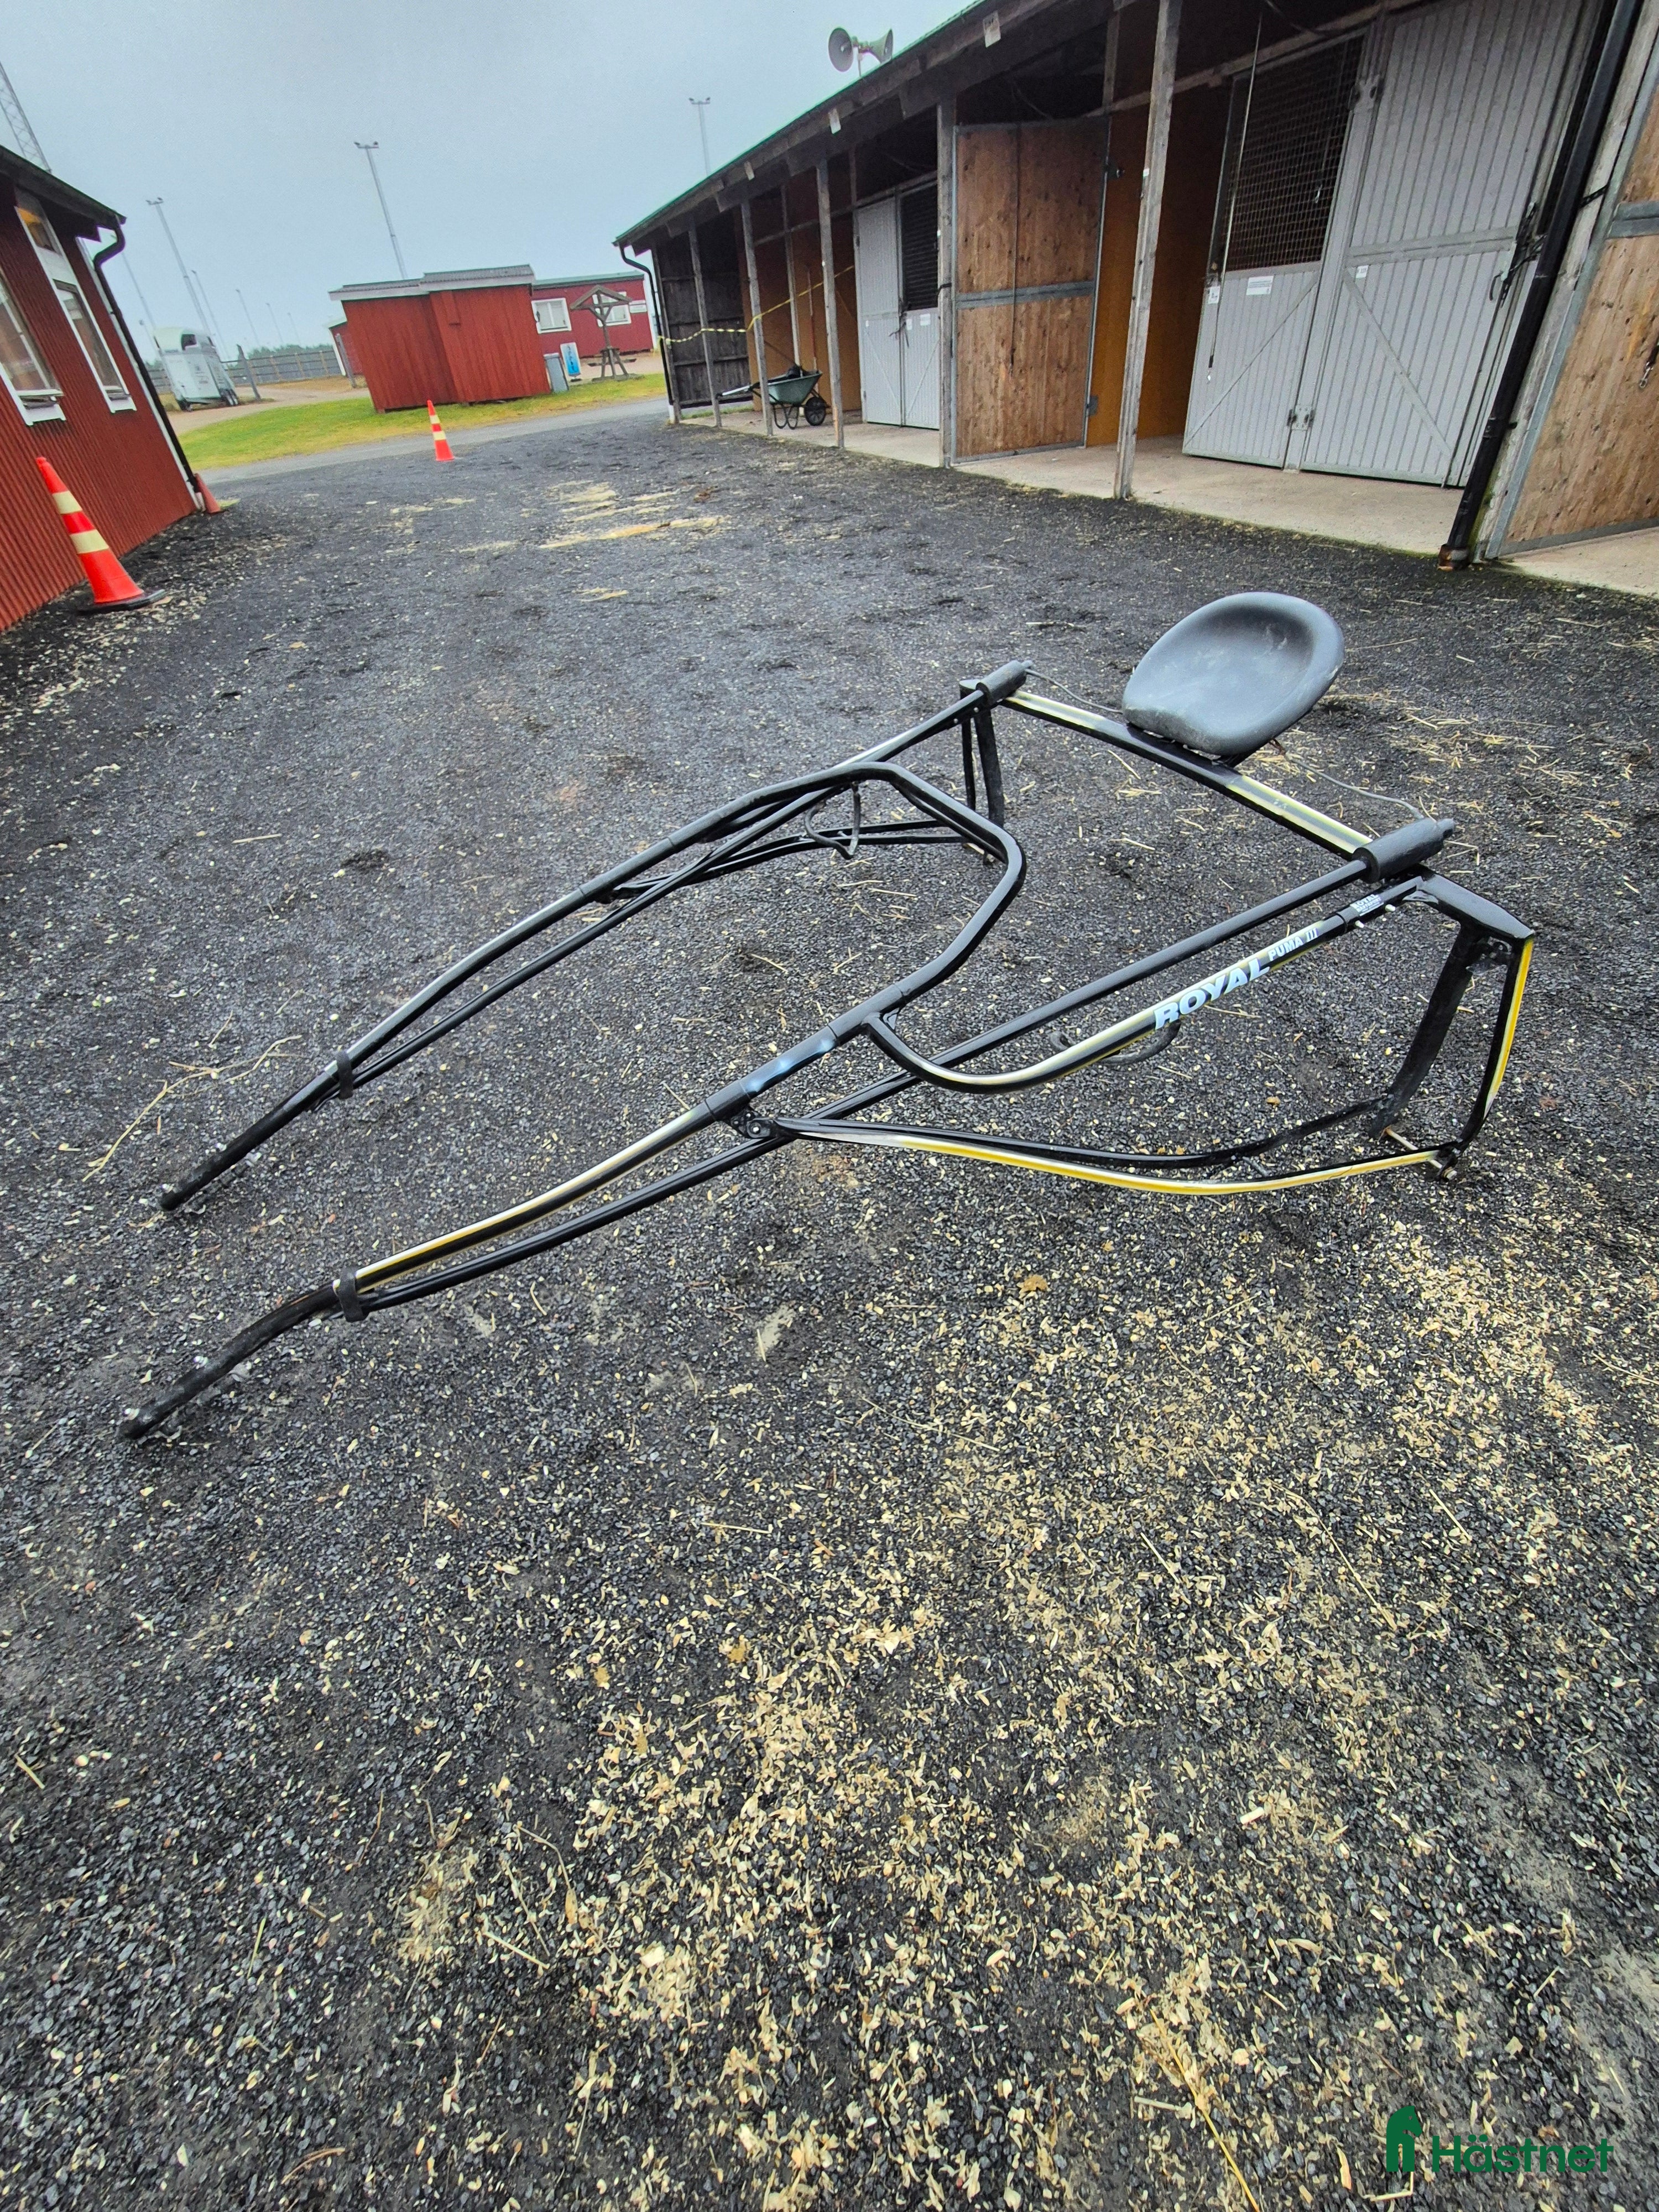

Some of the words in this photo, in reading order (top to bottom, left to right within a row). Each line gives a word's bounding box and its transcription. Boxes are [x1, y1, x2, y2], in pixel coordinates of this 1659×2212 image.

[1350, 894, 1380, 909] ROYAL
[1154, 958, 1270, 1030] ROYAL
[1268, 936, 1303, 962] PUMA
[1305, 927, 1319, 942] III
